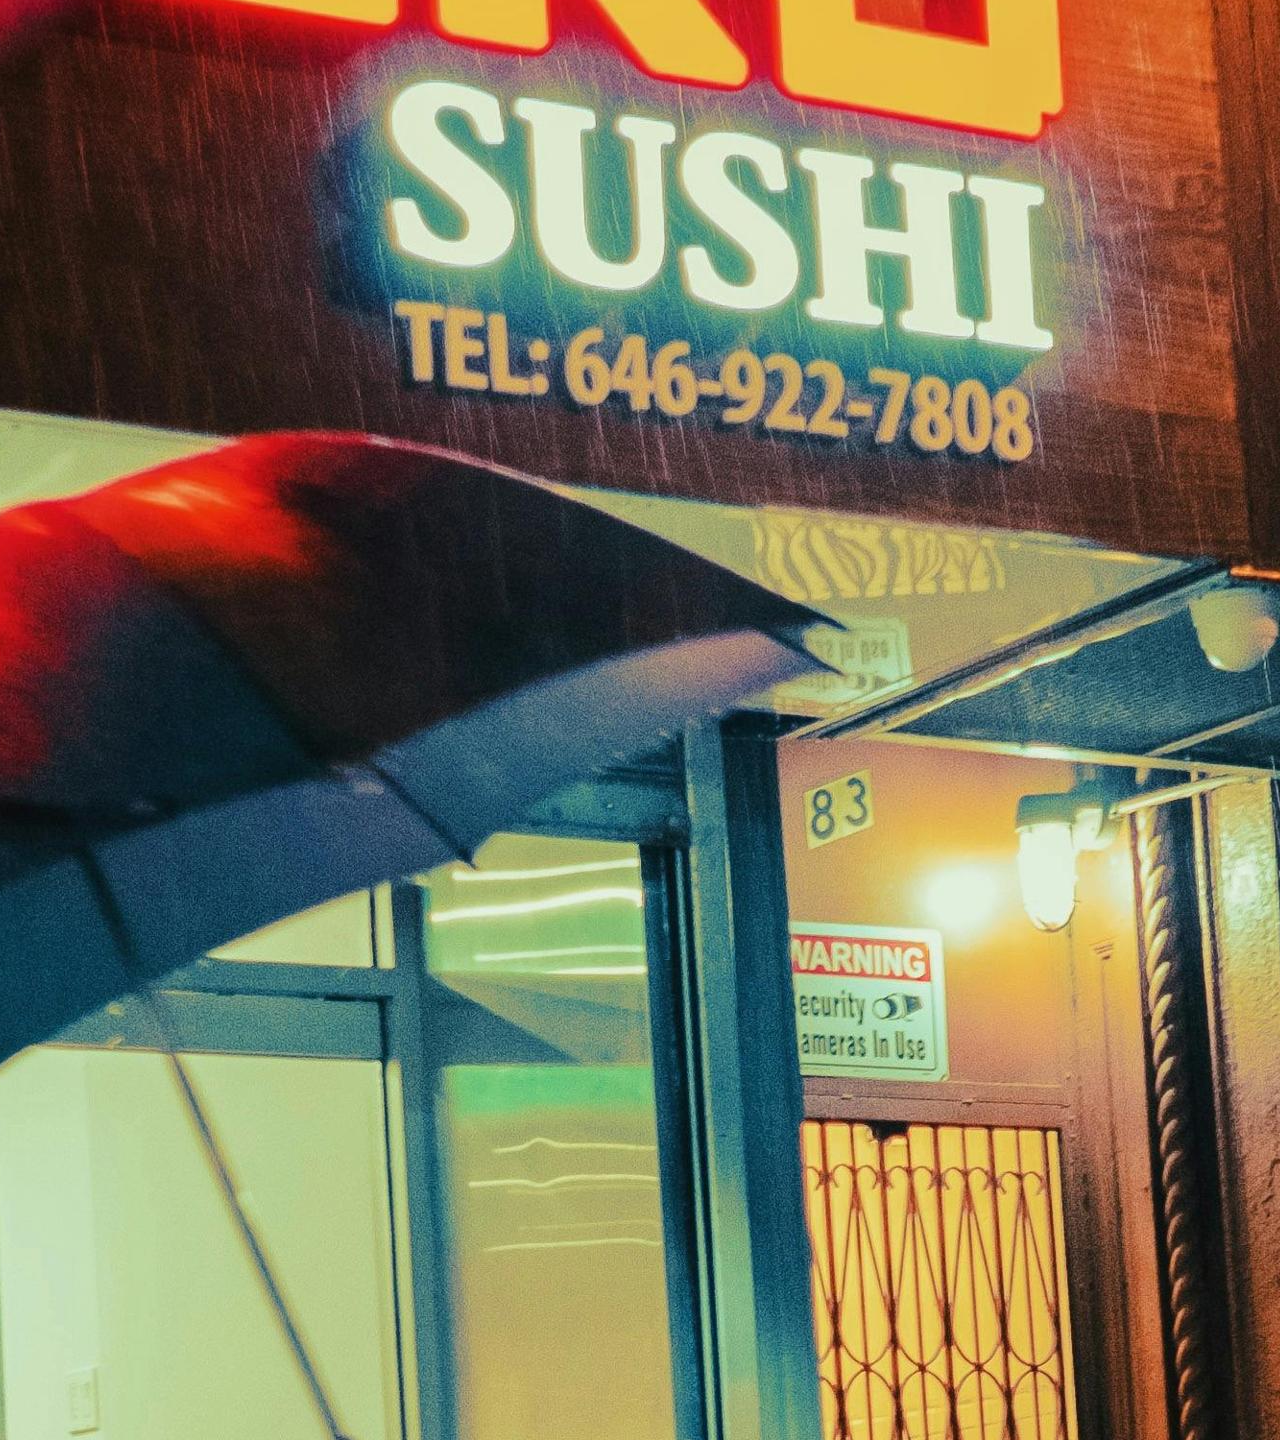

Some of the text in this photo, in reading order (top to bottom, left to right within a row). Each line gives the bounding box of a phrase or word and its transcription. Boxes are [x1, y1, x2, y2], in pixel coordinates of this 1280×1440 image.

[387, 79, 1054, 351] SUSHI
[395, 301, 1035, 463] TEL: 646-922-7808
[810, 776, 870, 841] 83
[791, 939, 927, 979] WARNING
[799, 989, 865, 1025] ecurity
[801, 1029, 926, 1060] ameras In Use
